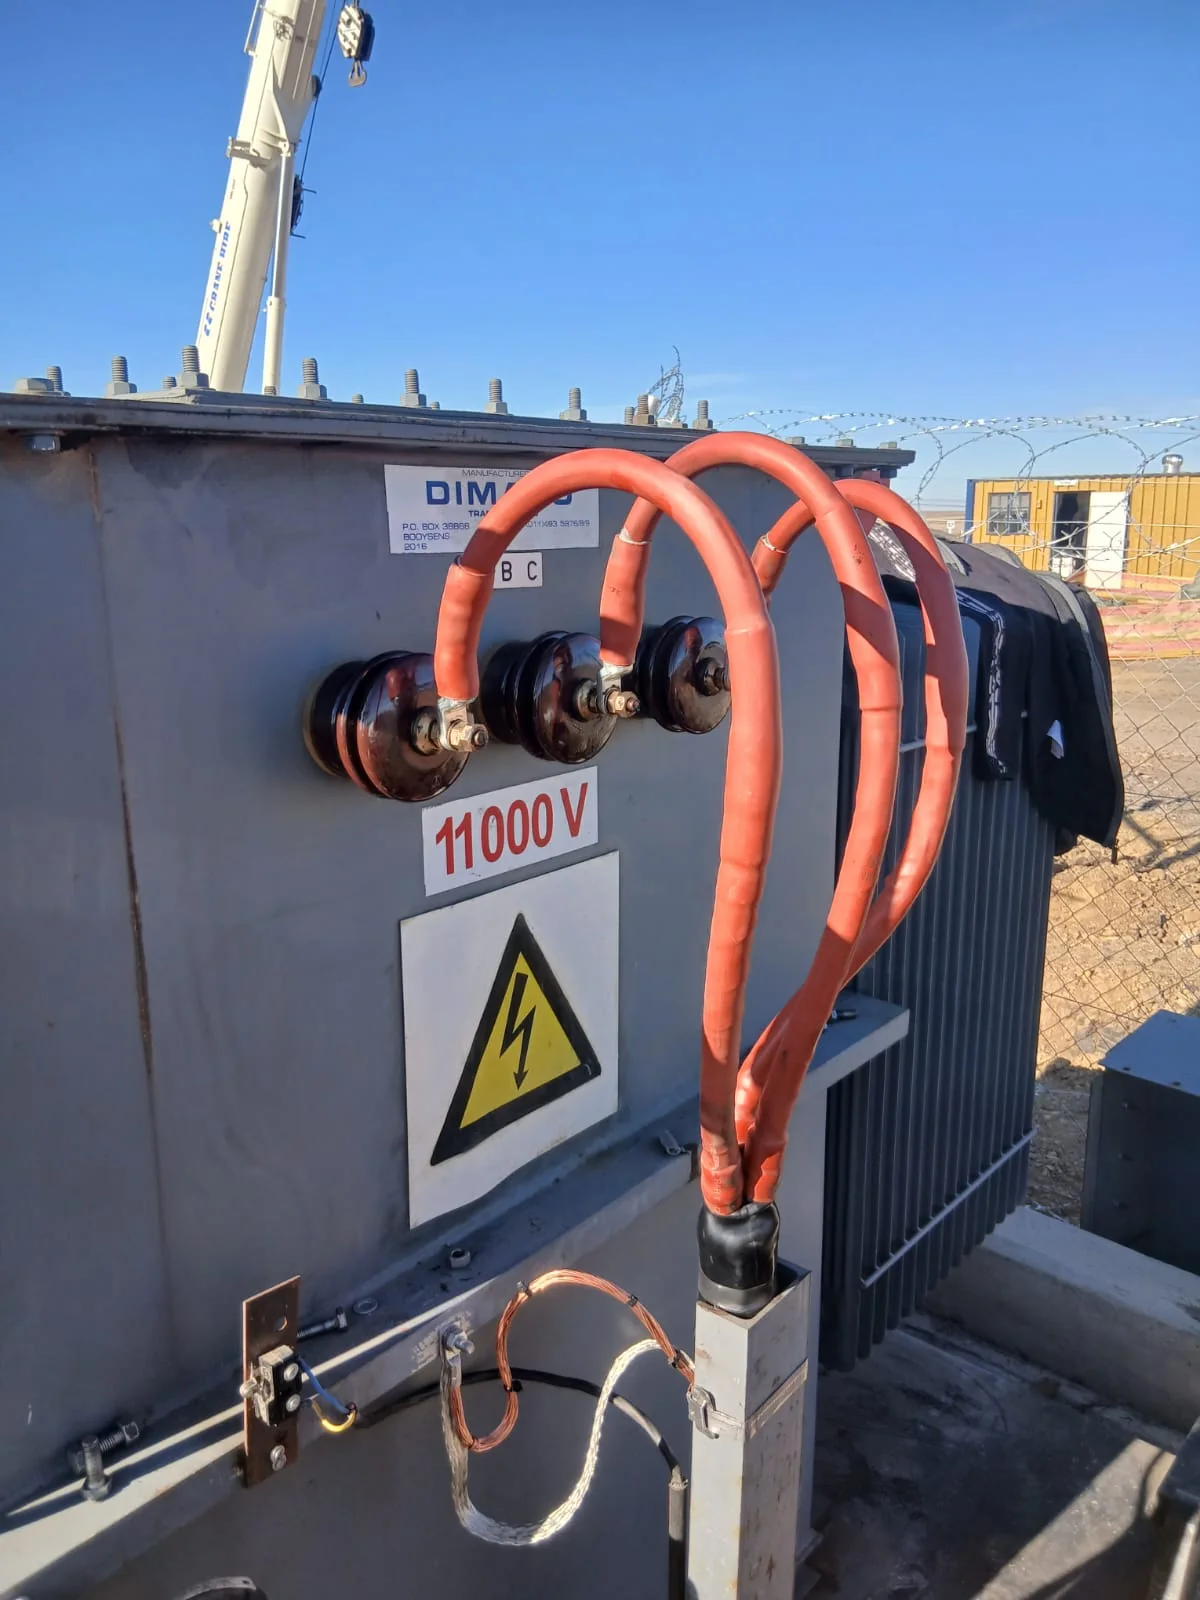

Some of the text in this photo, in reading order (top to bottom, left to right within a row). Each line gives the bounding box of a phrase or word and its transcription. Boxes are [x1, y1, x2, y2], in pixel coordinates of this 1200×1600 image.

[422, 522, 440, 531] BOX
[403, 532, 451, 541] BOOYSENS
[404, 542, 428, 551] 2016
[501, 561, 538, 582] B C
[435, 782, 589, 876] 11000 V
